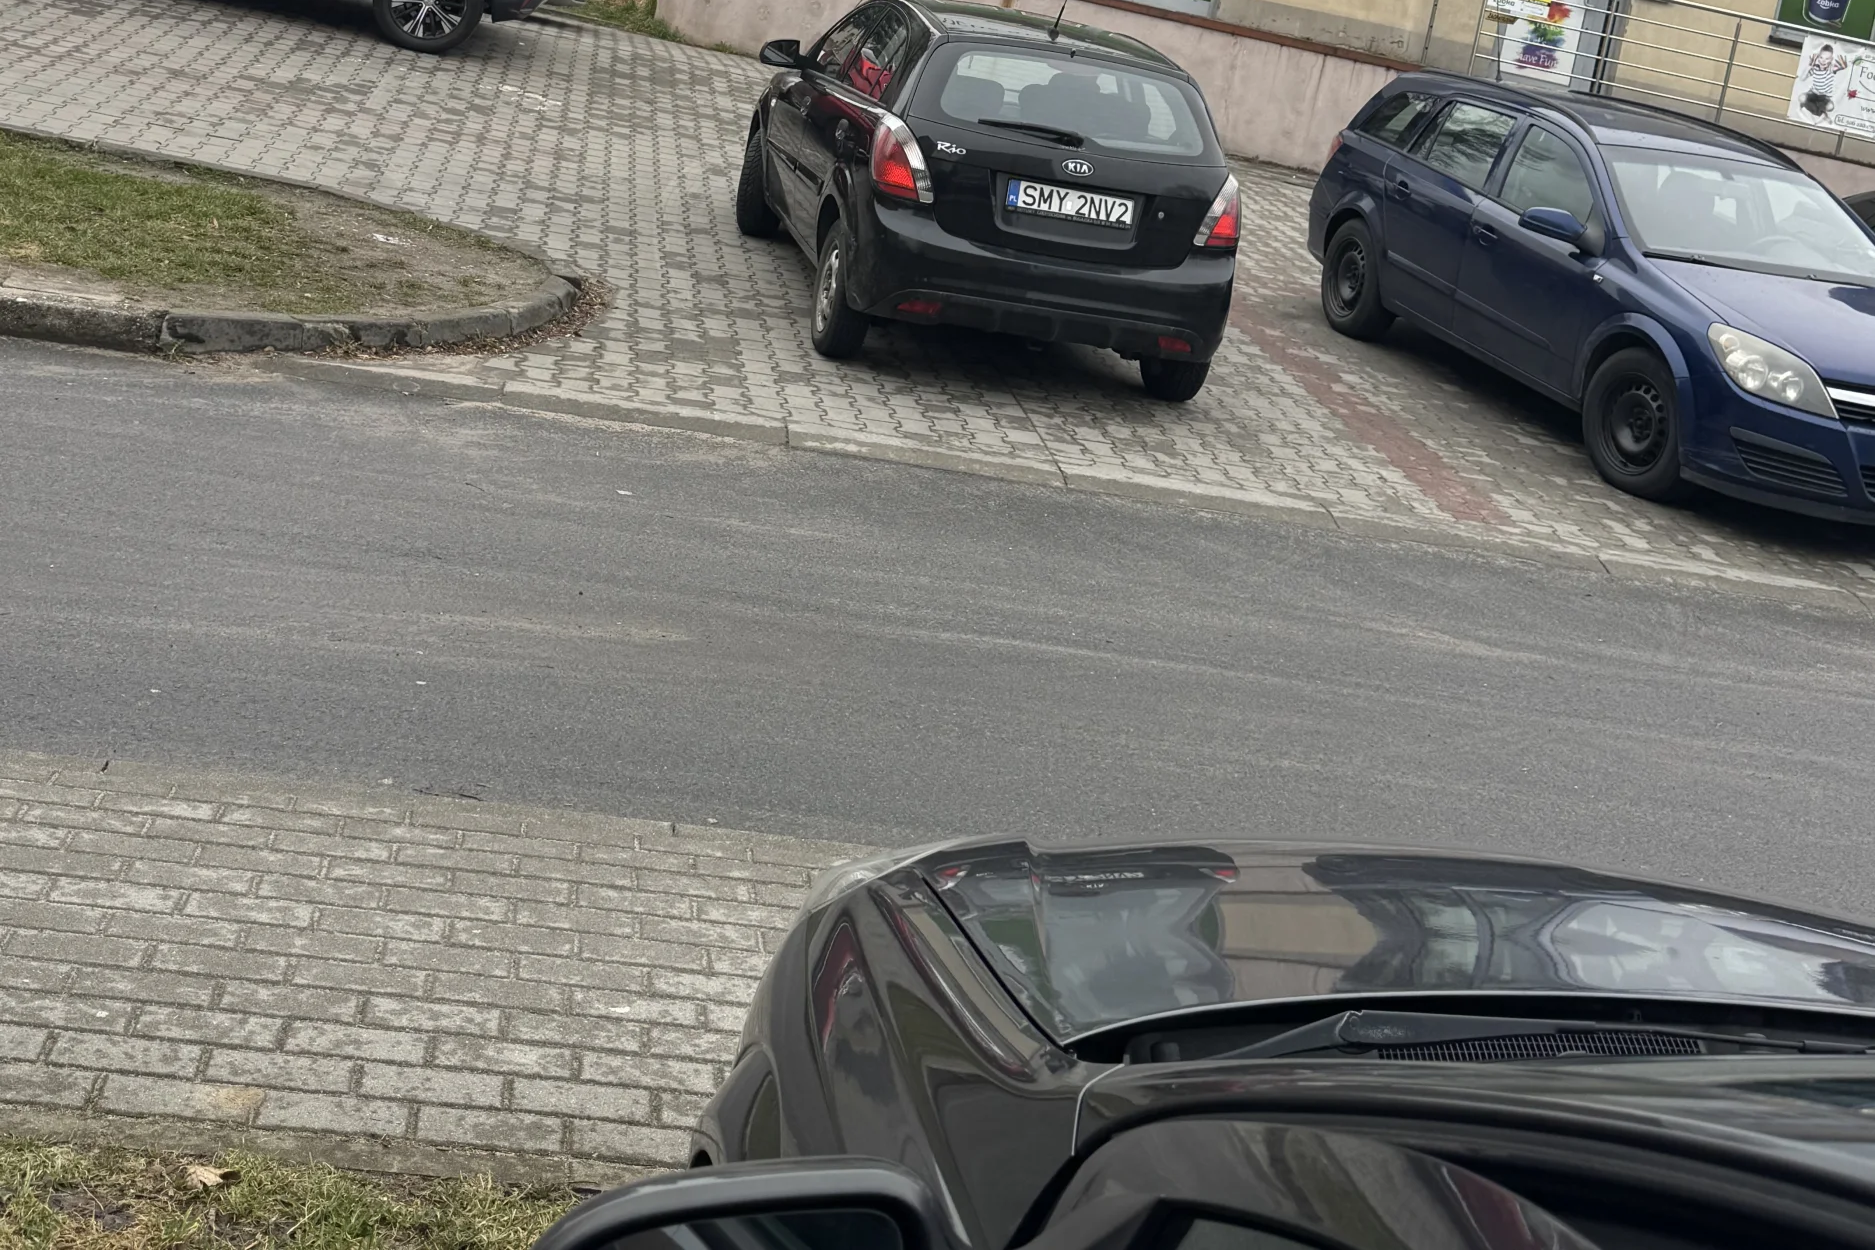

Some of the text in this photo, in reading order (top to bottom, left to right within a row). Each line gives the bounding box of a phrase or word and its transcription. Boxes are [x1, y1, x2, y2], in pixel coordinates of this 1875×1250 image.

[936, 140, 967, 155] Rio
[1067, 162, 1089, 174] KIA
[1022, 184, 1129, 224] SMY 2NV2
